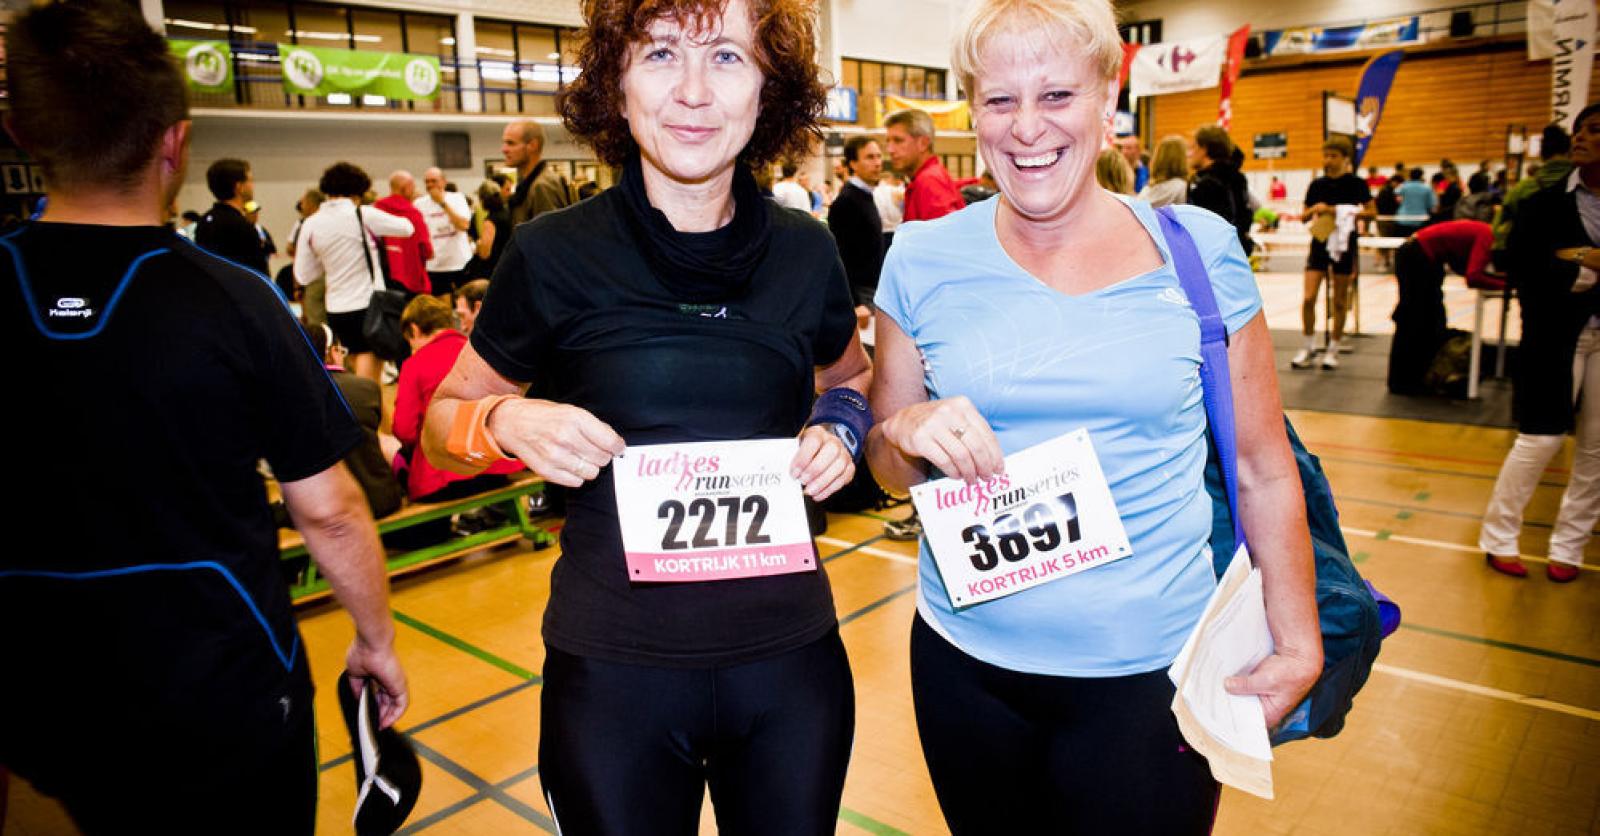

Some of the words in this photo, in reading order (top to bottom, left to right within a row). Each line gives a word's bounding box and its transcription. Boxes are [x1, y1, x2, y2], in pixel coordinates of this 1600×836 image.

[637, 451, 720, 484] ladies
[657, 495, 771, 551] 2272
[961, 492, 1082, 572] 3897
[654, 556, 739, 575] KORTRIJK
[741, 555, 757, 569] 11
[761, 552, 787, 567] km
[967, 558, 1061, 597] KORTRIJK
[1063, 553, 1076, 570] 5
[1079, 545, 1110, 564] km
